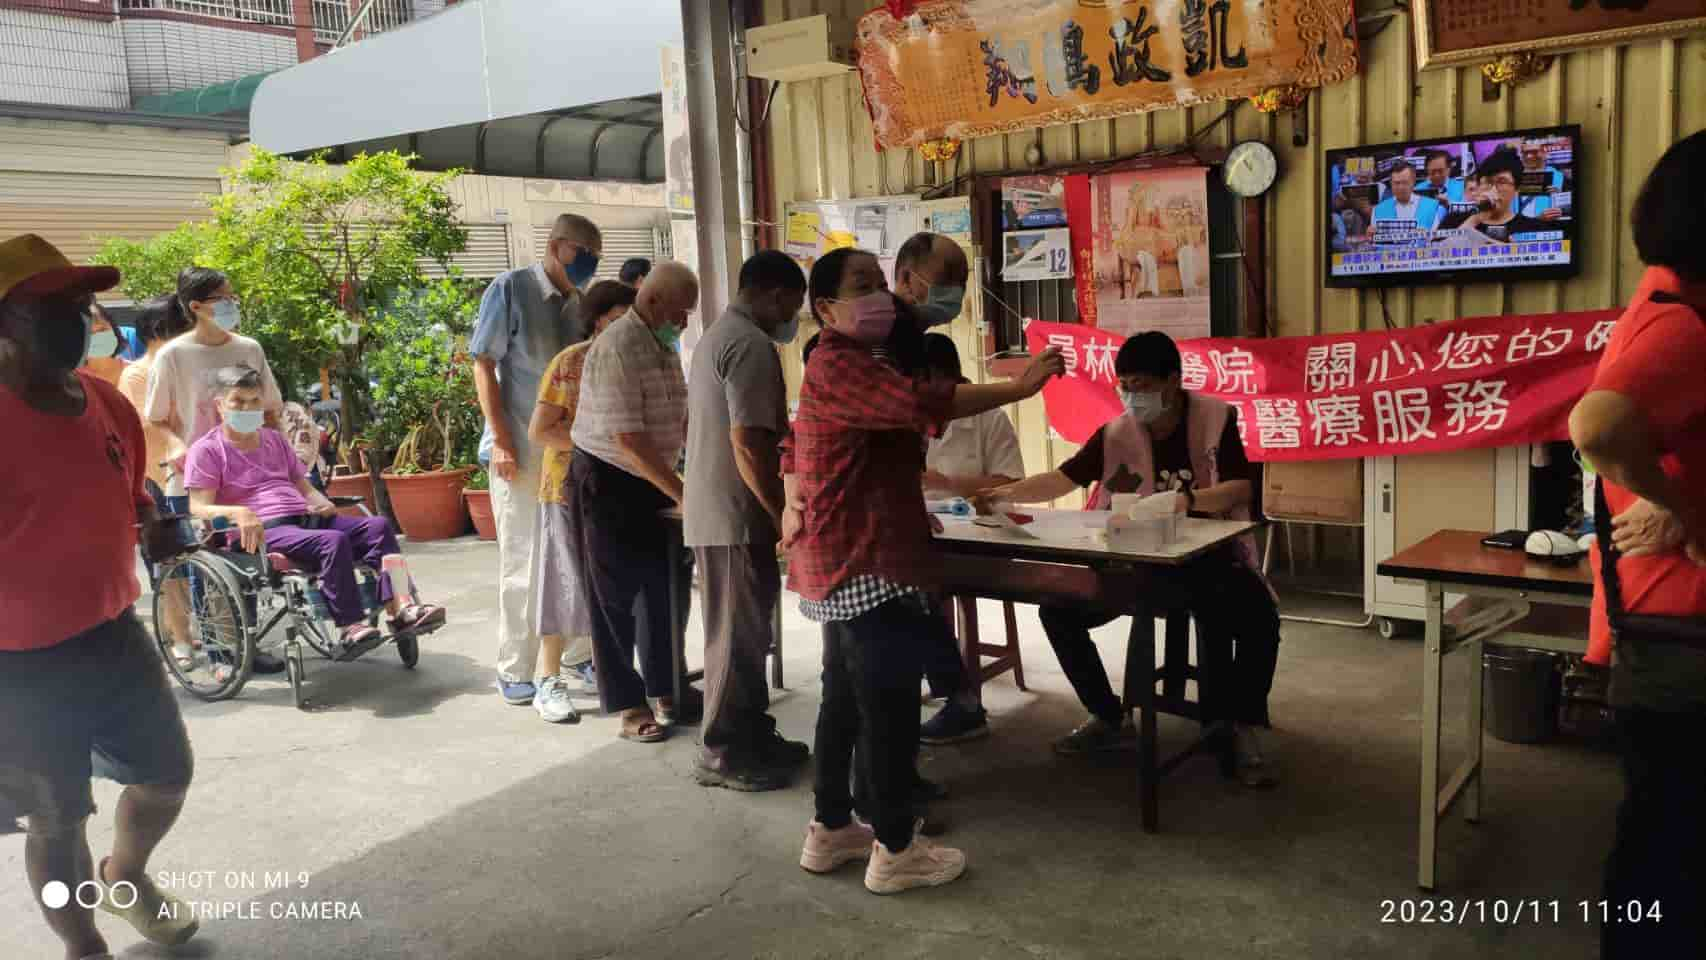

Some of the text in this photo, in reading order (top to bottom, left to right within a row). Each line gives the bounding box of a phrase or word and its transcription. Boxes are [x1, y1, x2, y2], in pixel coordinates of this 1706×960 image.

[1050, 247, 1067, 273] 12
[1047, 335, 1258, 394] 員林醫院
